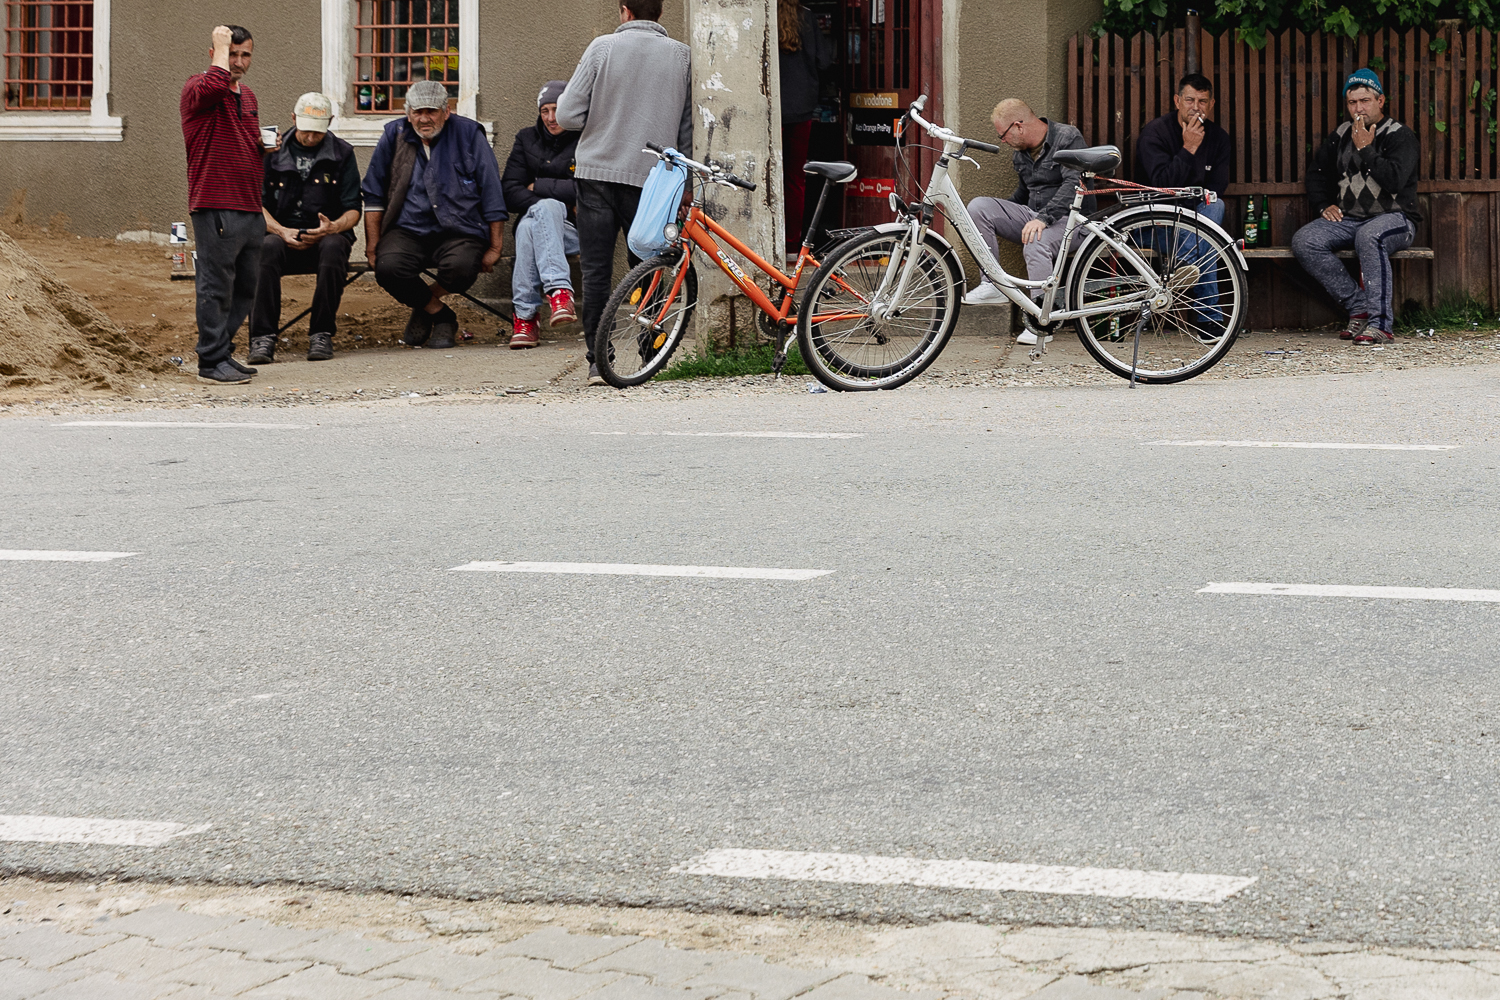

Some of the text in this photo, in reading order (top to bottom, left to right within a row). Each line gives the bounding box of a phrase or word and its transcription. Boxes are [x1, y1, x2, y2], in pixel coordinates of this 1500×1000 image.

[863, 94, 893, 106] vodafone
[862, 123, 877, 134] Orange
[949, 199, 1000, 275] STEVENS
